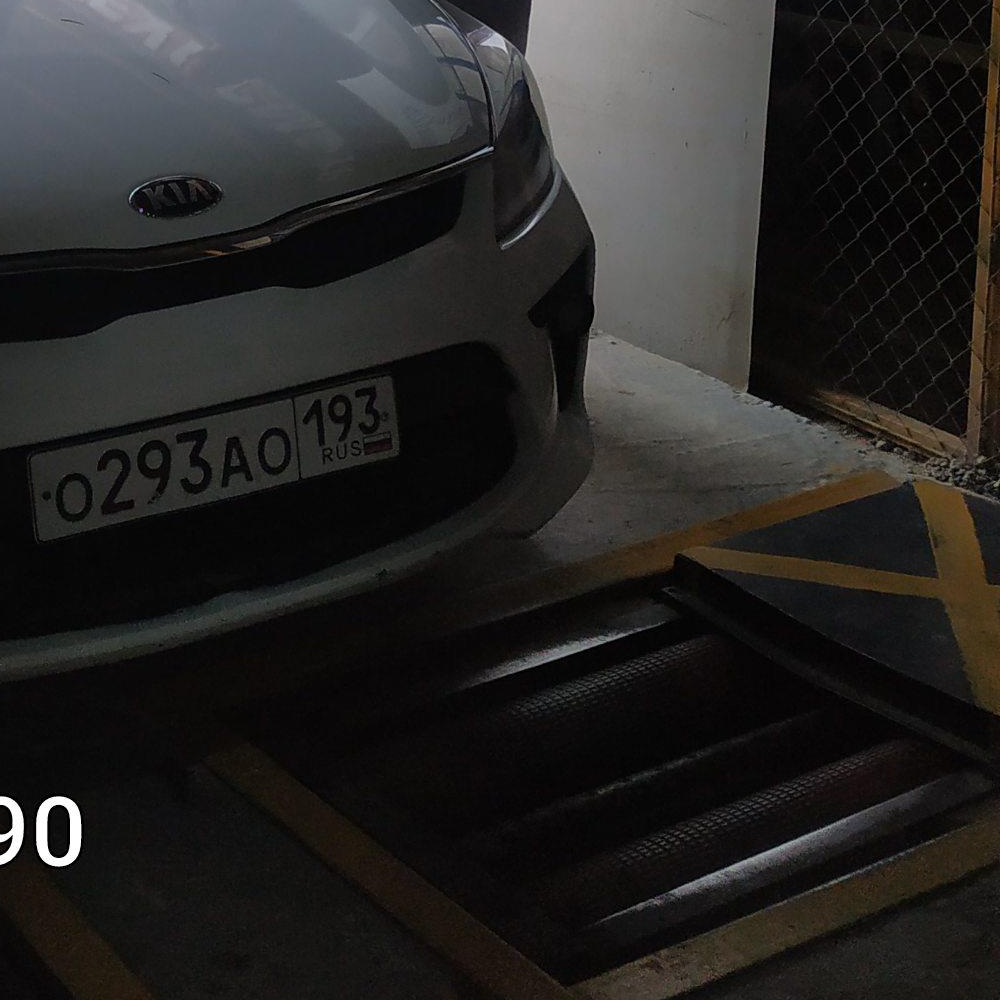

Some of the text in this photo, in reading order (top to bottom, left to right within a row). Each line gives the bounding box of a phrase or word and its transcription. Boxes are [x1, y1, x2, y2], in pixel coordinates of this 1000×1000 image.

[141, 179, 216, 208] KIA
[302, 386, 381, 446] 193
[321, 440, 362, 464] RUS
